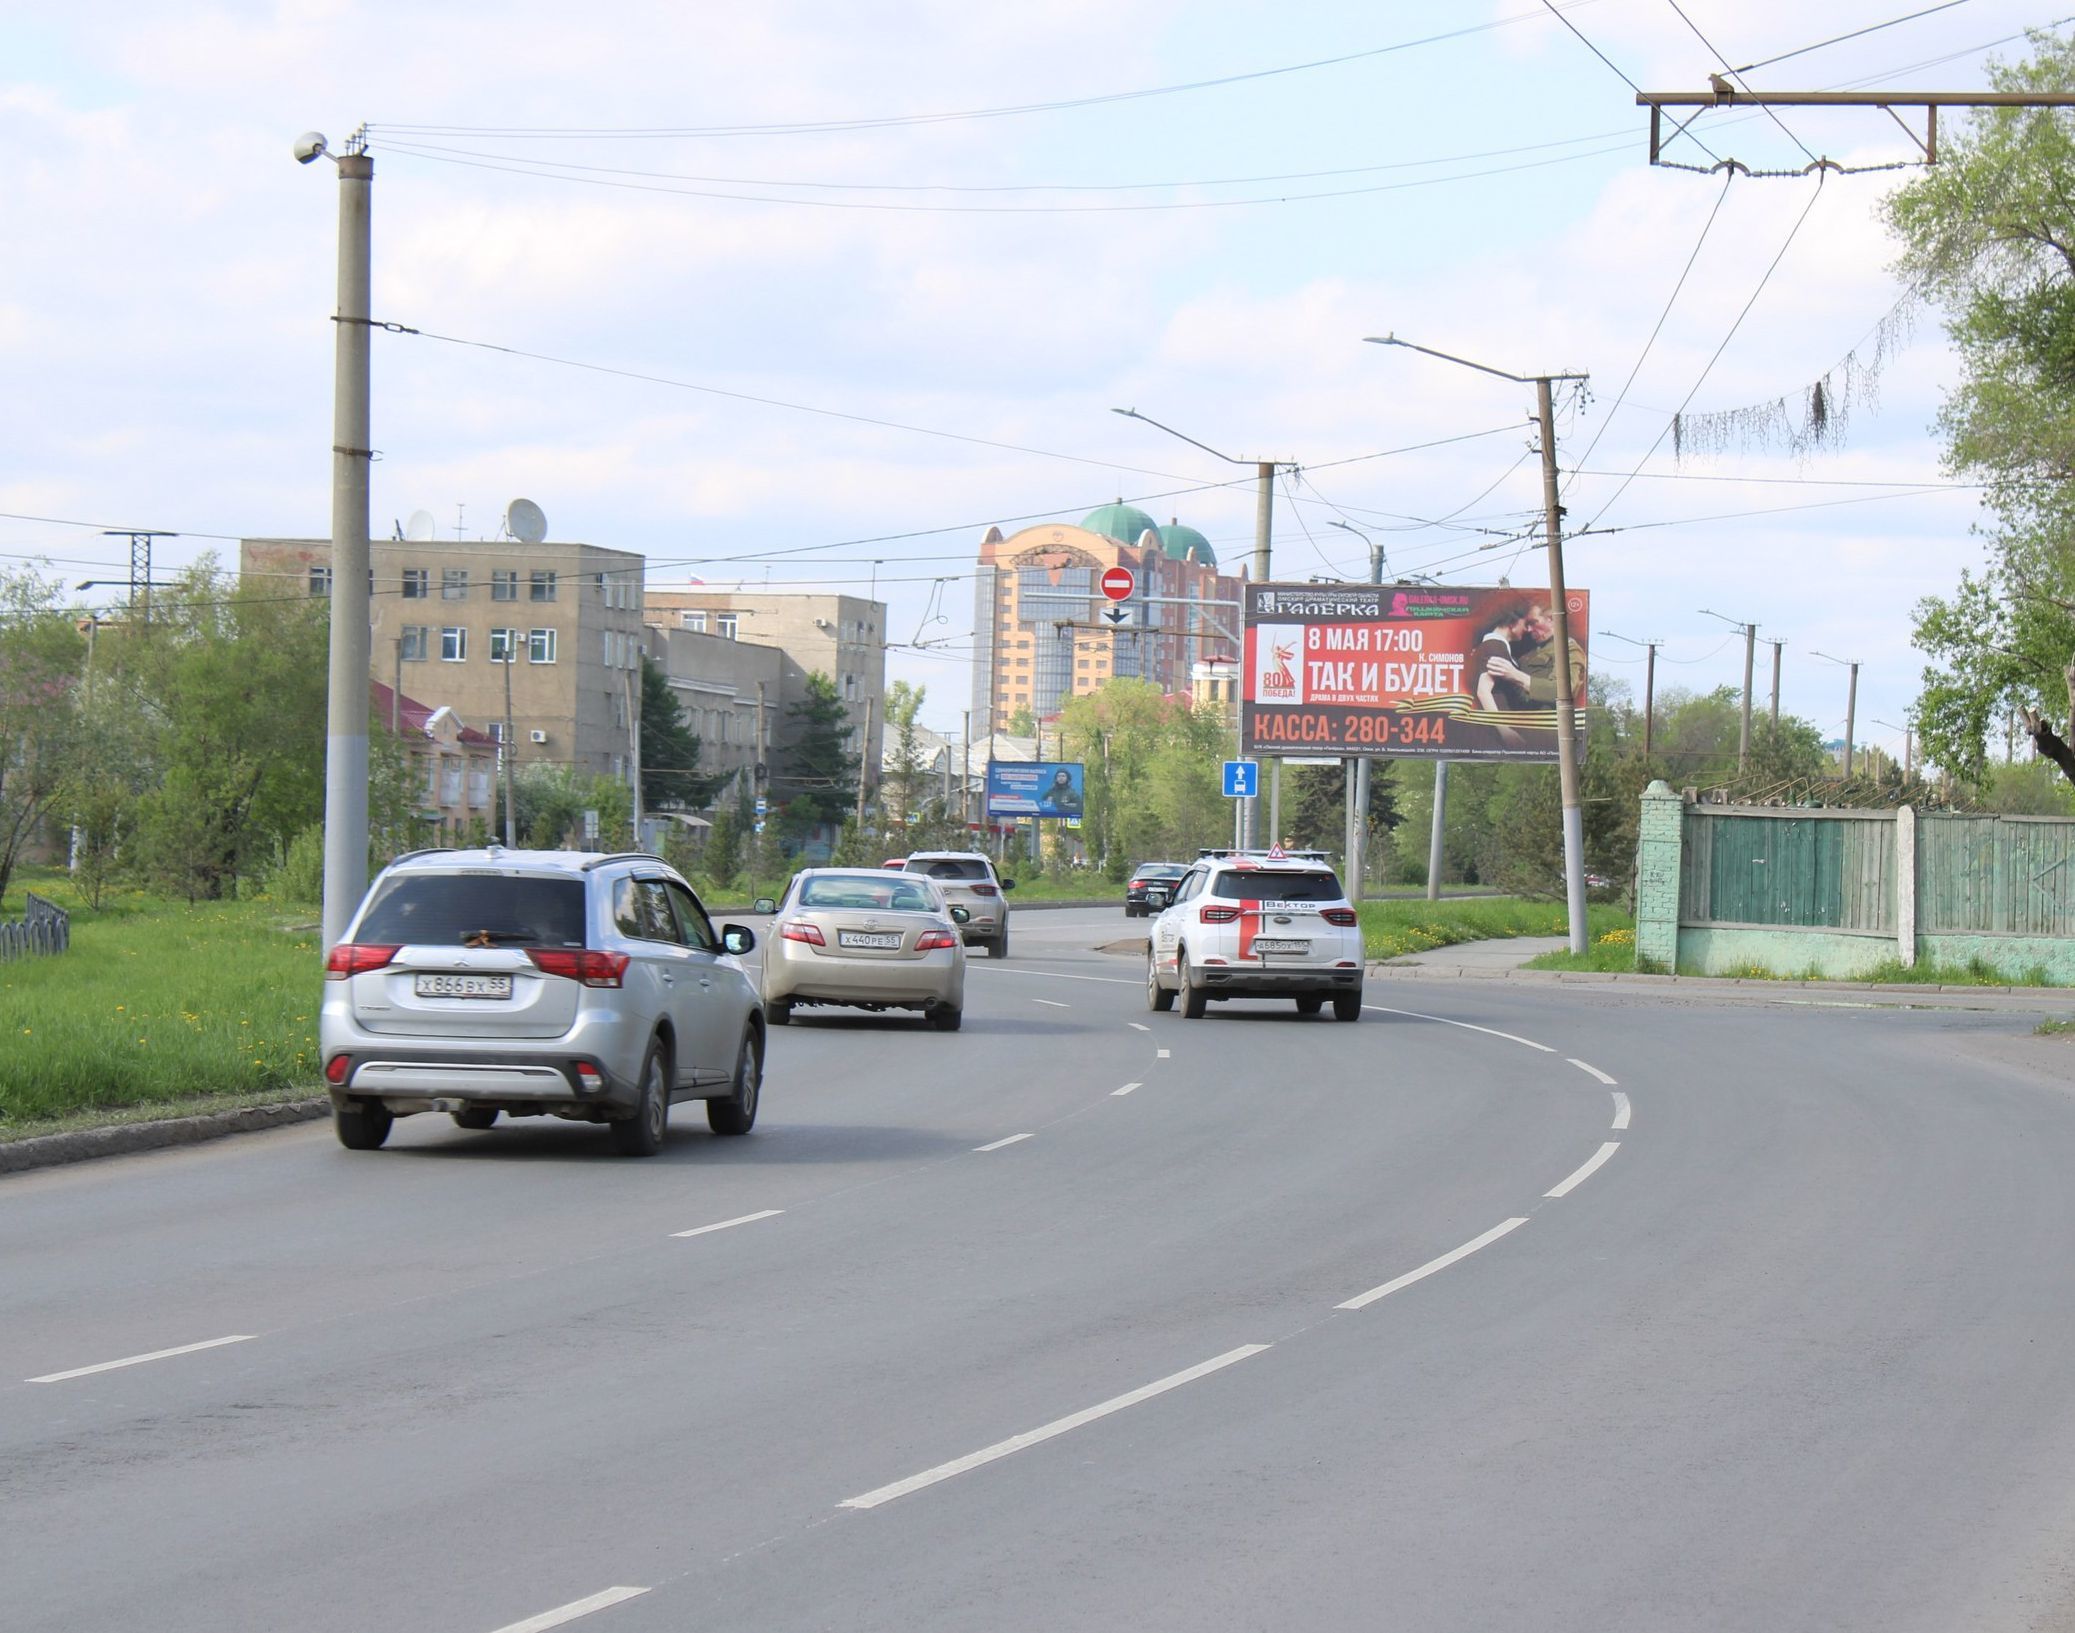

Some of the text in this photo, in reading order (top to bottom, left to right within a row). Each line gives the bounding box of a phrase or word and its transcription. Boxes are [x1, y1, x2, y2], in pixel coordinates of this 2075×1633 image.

[1308, 628, 1423, 652] 8 МАЯ 17:00
[1428, 653, 1464, 662] СИМОНОВ
[1263, 671, 1281, 687] 80
[1308, 662, 1464, 695] ТАК И БУДЕТ
[1310, 694, 1332, 702] ДРАМА
[1254, 714, 1446, 744] КАССА: 280-344
